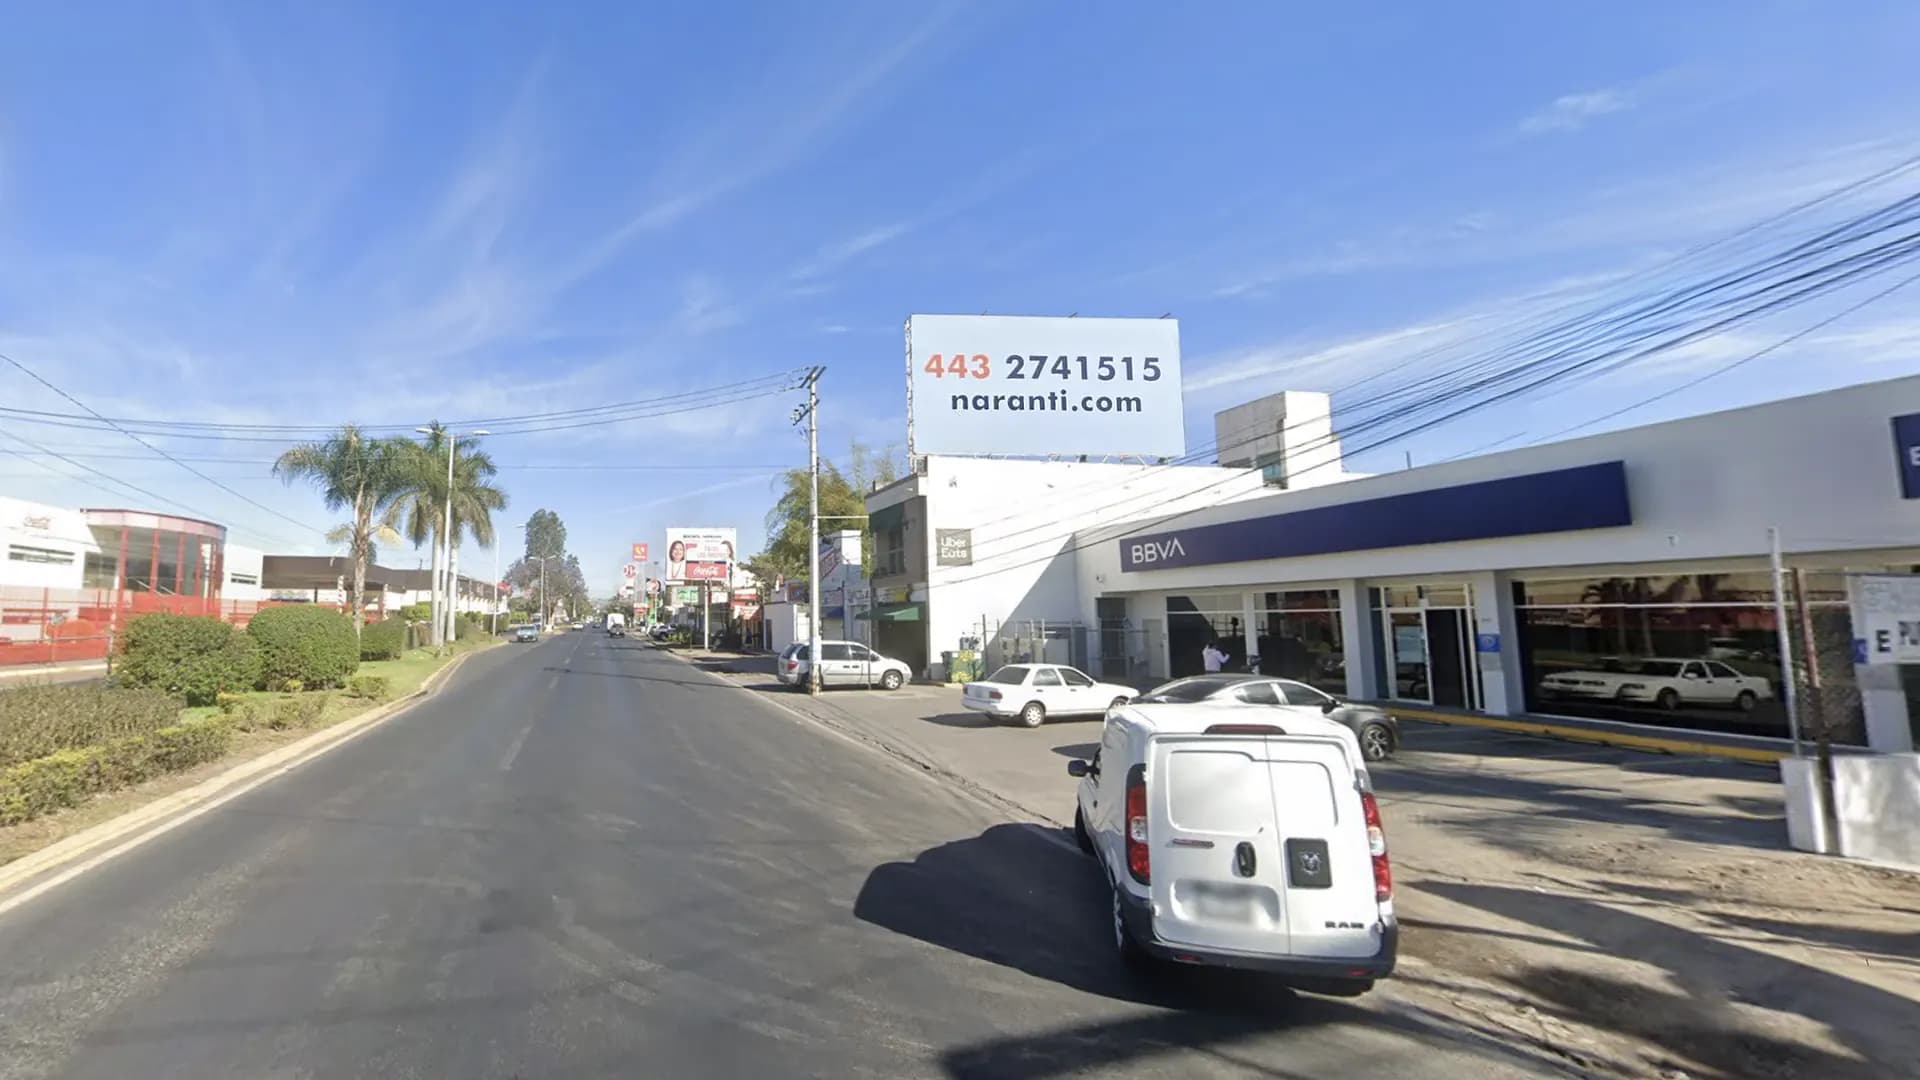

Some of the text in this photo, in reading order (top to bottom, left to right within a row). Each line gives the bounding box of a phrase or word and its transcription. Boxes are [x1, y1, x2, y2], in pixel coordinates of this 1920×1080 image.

[924, 354, 1161, 381] 443 2741515
[951, 389, 1142, 412] naranti.com
[940, 536, 967, 547] Uber
[1132, 537, 1186, 563] BBVA
[941, 547, 967, 558] Eats
[1324, 920, 1364, 930] RAM
